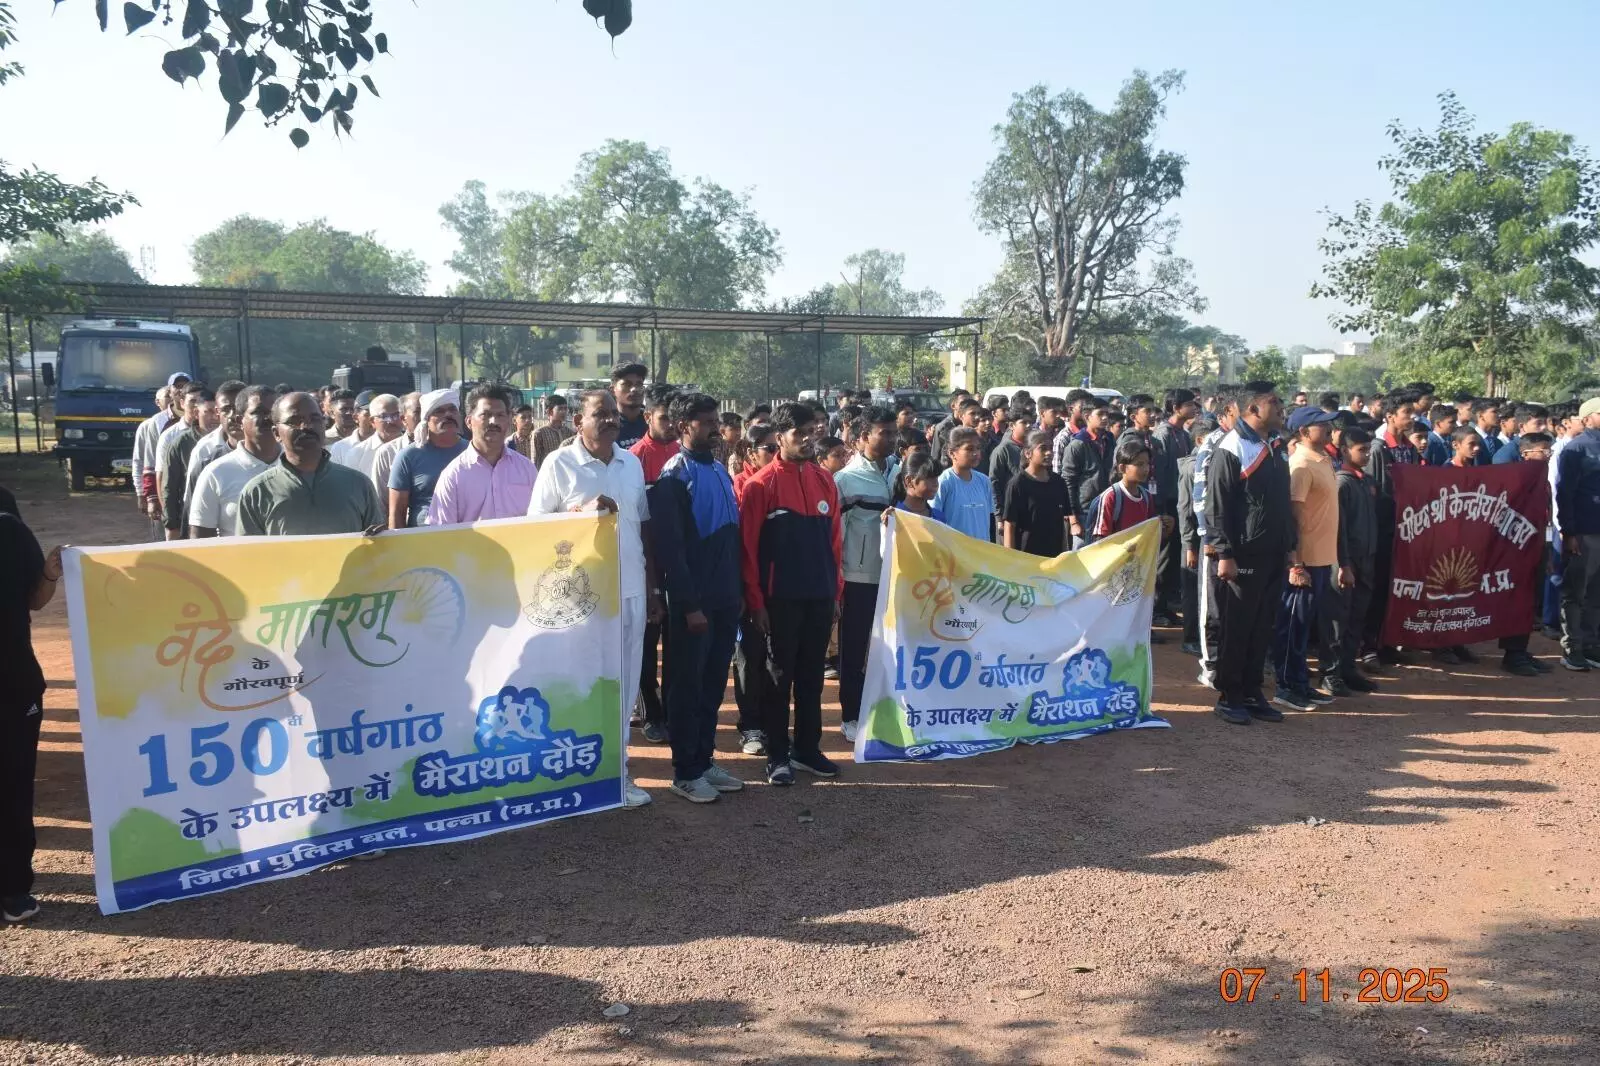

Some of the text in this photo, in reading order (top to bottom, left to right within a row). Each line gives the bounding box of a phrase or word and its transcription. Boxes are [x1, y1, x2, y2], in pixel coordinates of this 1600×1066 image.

[1431, 486, 1450, 524] श्री
[223, 673, 305, 694] गौरवपूर्ण
[251, 657, 270, 672] के
[905, 703, 923, 728] के
[997, 702, 1018, 723] में
[1031, 691, 1100, 722] मैराथन
[138, 716, 290, 798] 150
[179, 806, 219, 841] के
[362, 770, 394, 802] में
[420, 753, 533, 791] मैराथन
[540, 735, 599, 777] दौड़
[178, 862, 262, 891] जिला
[267, 842, 356, 870] पुलिस
[423, 807, 494, 834] पन्ना
